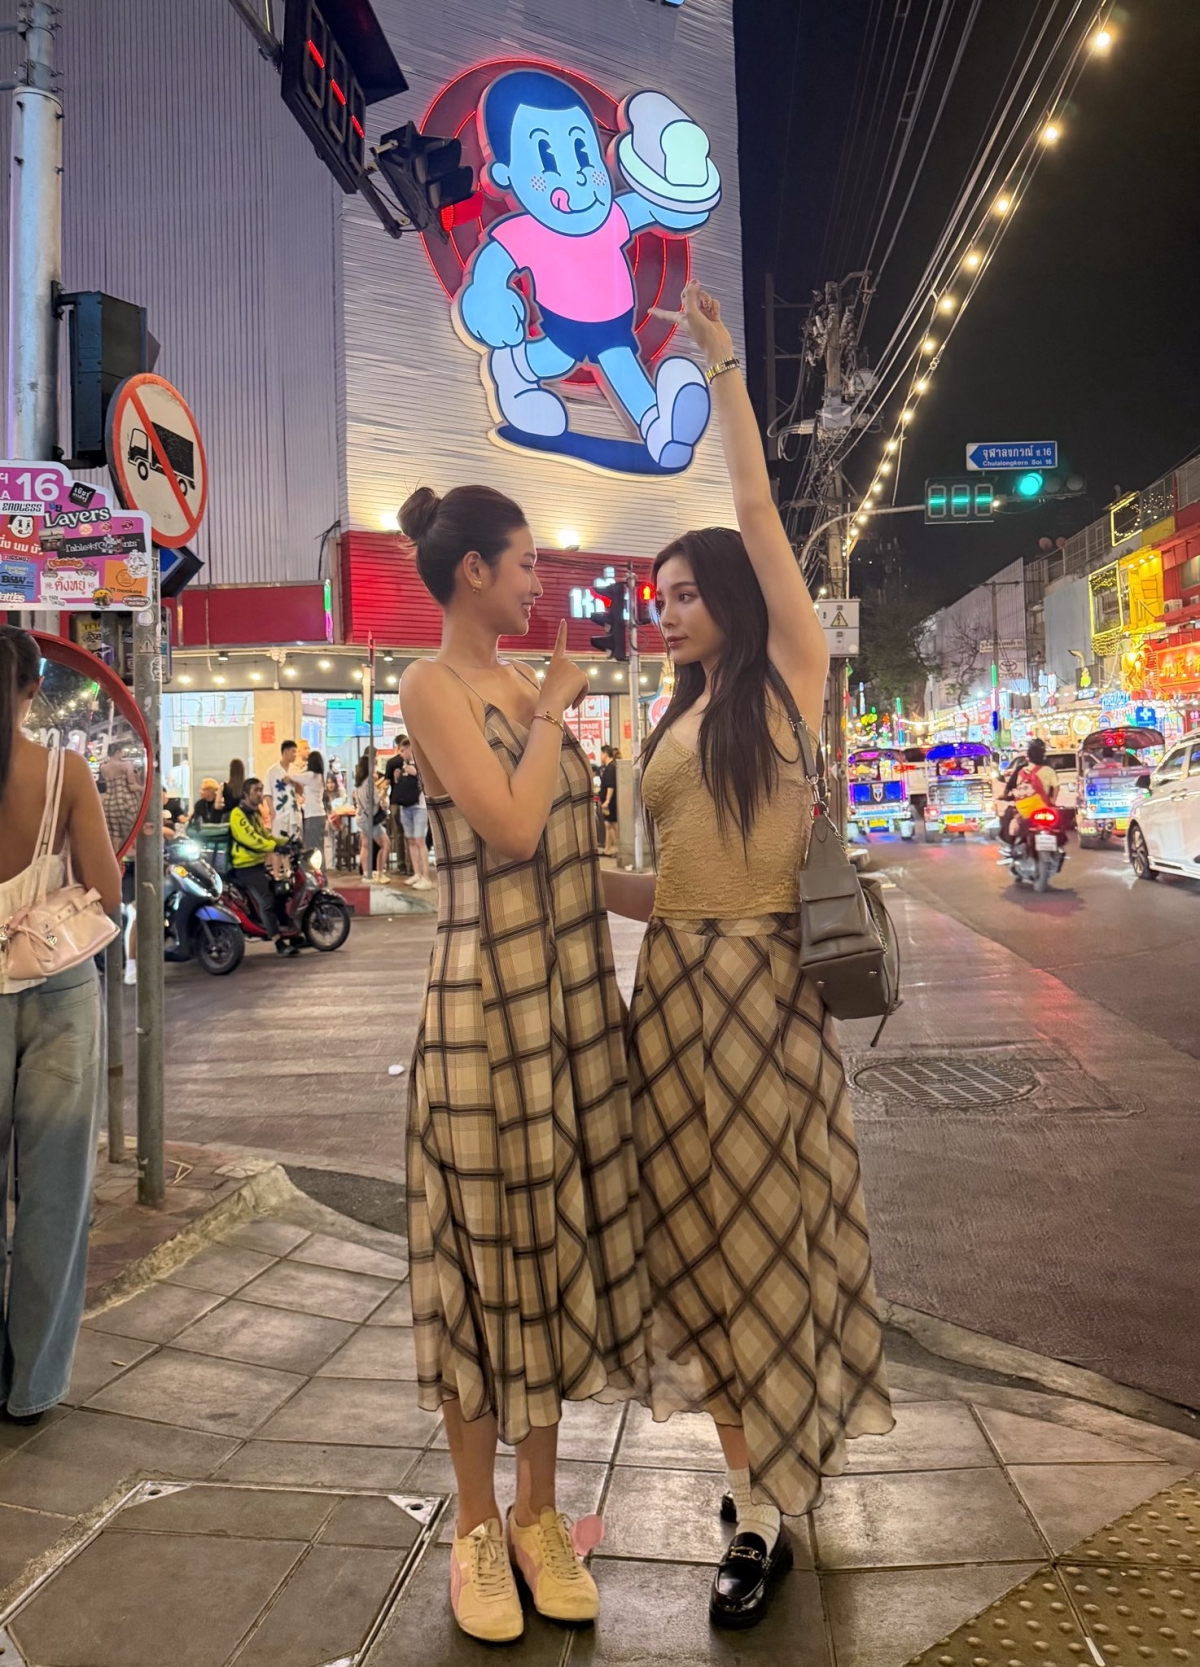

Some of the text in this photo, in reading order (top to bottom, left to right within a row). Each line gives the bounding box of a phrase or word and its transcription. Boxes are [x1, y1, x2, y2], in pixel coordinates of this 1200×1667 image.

[983, 446, 1034, 460] จุฬาลงกรณ์
[15, 472, 60, 501] 16
[44, 508, 110, 528] Layers
